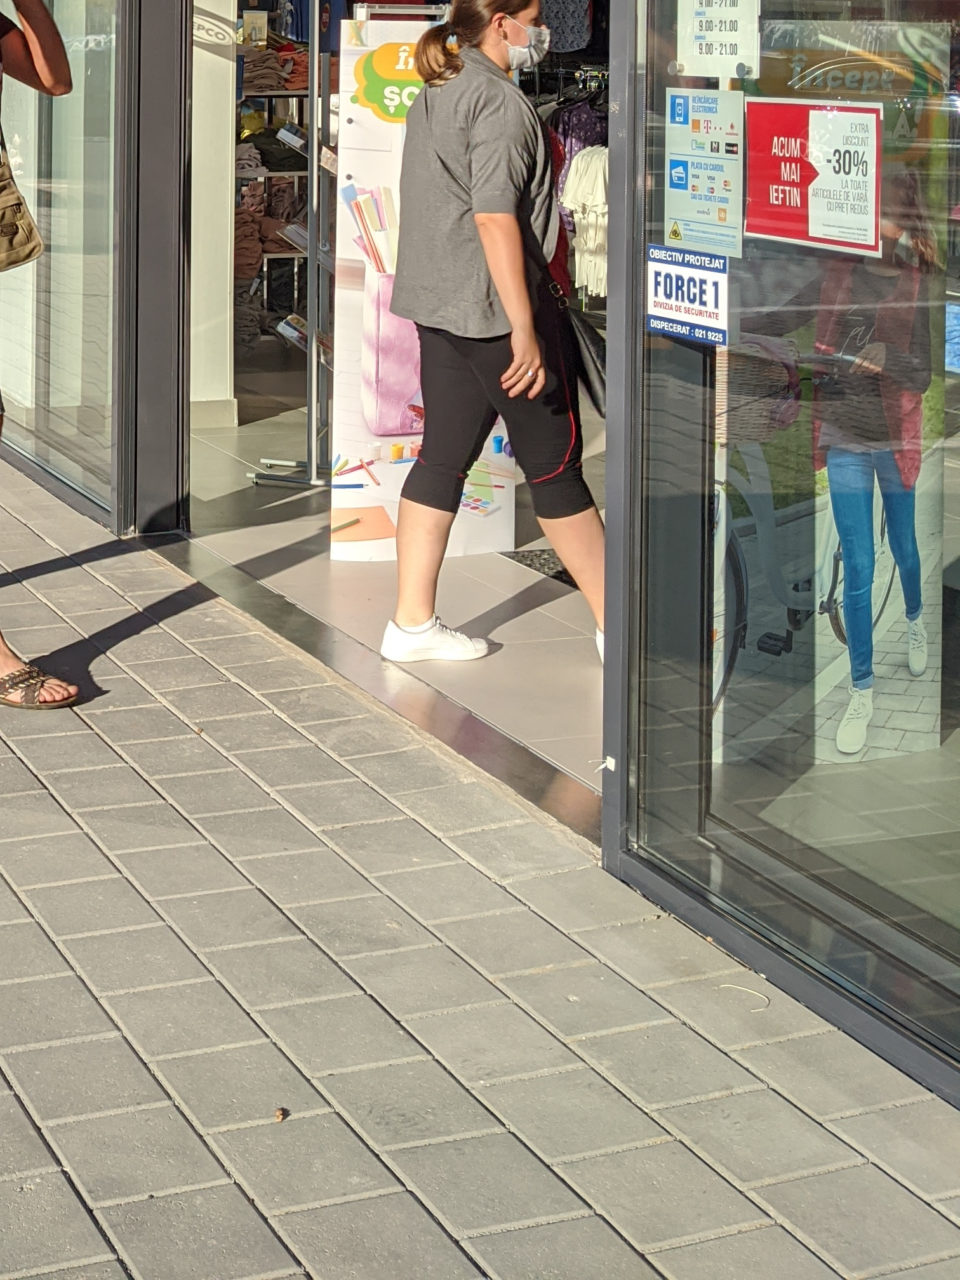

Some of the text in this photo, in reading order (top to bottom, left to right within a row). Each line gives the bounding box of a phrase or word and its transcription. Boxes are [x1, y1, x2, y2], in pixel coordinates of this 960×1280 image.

[850, 122, 869, 133] EXTRA
[772, 136, 800, 158] ACUM
[843, 135, 869, 146] DISCOUNT
[781, 161, 800, 183] MAI
[826, 149, 868, 177] -30%
[770, 184, 800, 207] IEFTIN
[812, 188, 843, 200] ARTICOLELE
[843, 190, 850, 202] DE
[841, 180, 868, 191] LA TOATE
[826, 201, 834, 211] CU
[850, 203, 868, 215] REDUS
[649, 249, 724, 269] OBIECTIV PROTEJAT
[654, 270, 719, 309] FORCE 1
[653, 300, 719, 320] DIVIZIA DE SECURITATE
[650, 319, 690, 335] DISPECERAT
[695, 329, 706, 338] 021
[707, 330, 723, 342] 9225
